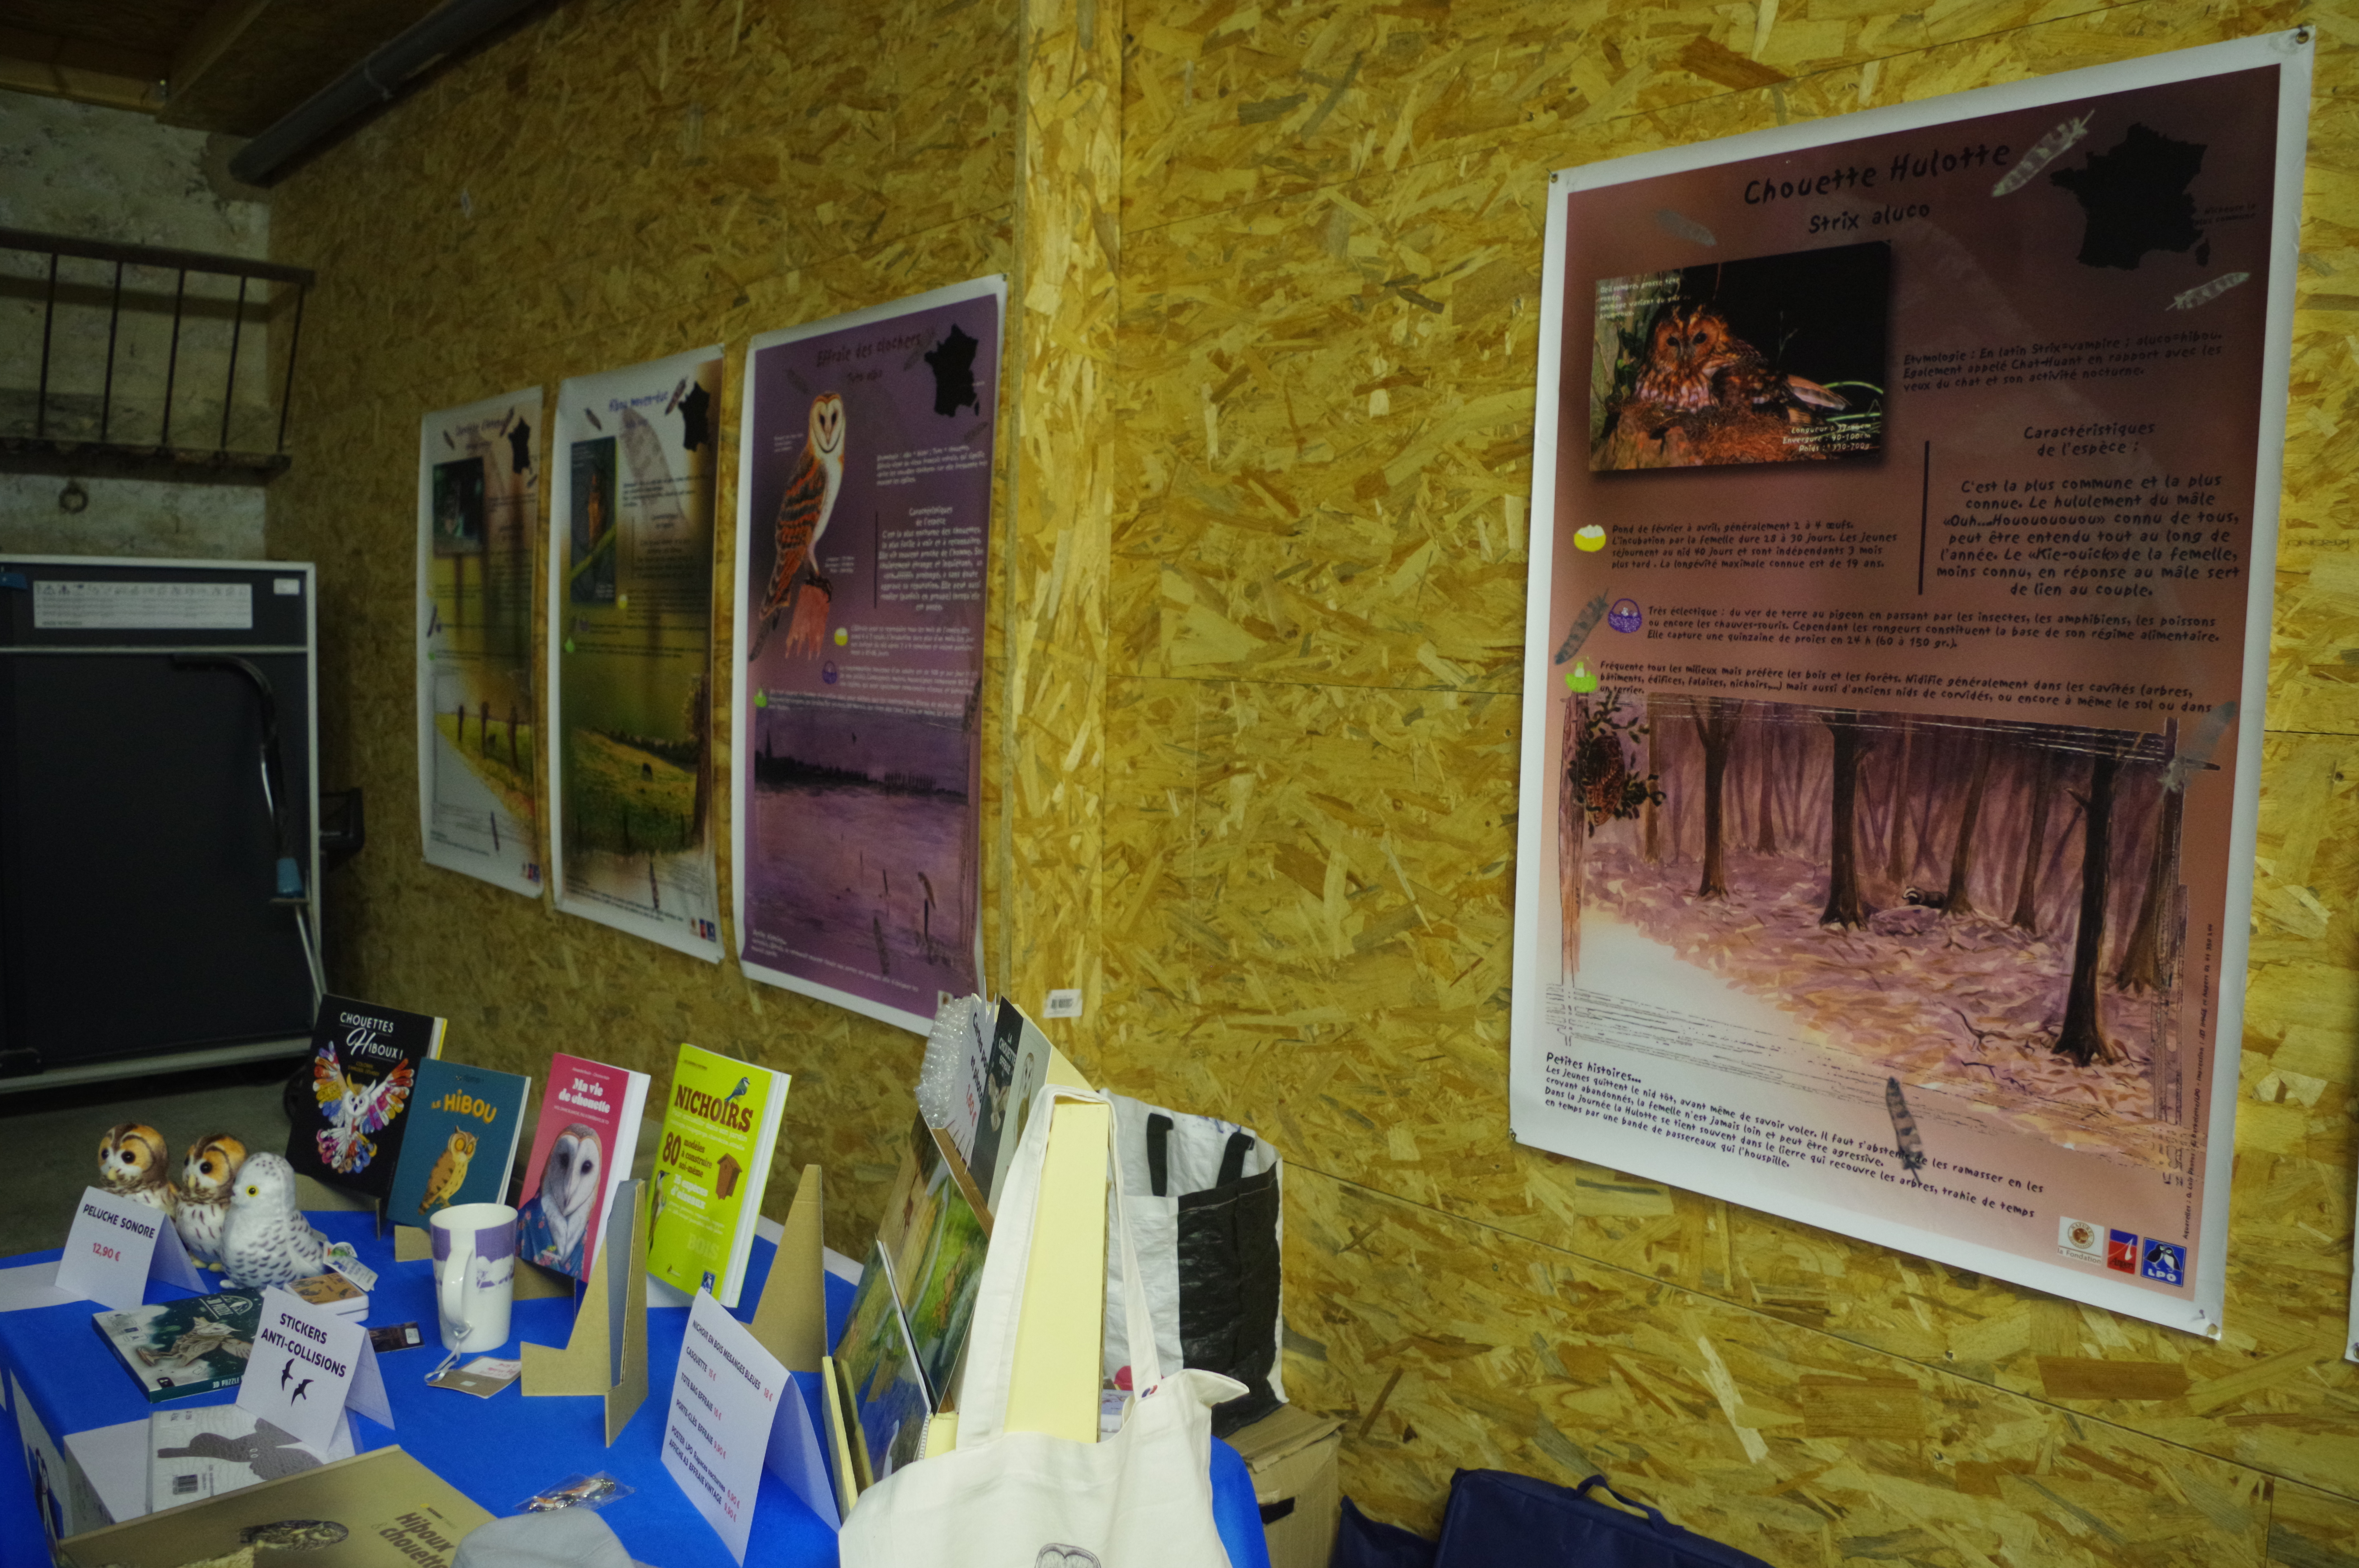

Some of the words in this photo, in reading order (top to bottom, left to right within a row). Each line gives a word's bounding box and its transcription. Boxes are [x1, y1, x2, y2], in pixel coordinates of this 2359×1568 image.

[1745, 168, 1876, 204] Chouette
[1890, 145, 2013, 180] Hulotte
[1808, 211, 1859, 234] Strix
[1872, 205, 1929, 224] aluco
[816, 347, 851, 367] Effraie
[856, 343, 872, 358] des
[1904, 350, 1966, 365] Etymologie
[1979, 348, 1994, 359] En
[1999, 345, 2026, 357] latin
[2032, 338, 2120, 354] Strix=vampire
[2137, 331, 2222, 345] aluco=hibou.
[1903, 365, 1962, 379] Egalement
[1968, 361, 2006, 373] appelé
[2012, 356, 2082, 369] Chat-Huant
[2088, 356, 2102, 364] en
[2109, 350, 2159, 362] rapport
[2165, 348, 2195, 358] avec
[2203, 345, 2222, 356] les
[2024, 423, 2155, 439] Caractéristiques
[2037, 444, 2055, 457] de
[2062, 443, 2126, 456] l'espèce
[1961, 480, 1997, 493] C'est
[2004, 479, 2017, 492] la
[2025, 479, 2054, 492] plus
[2062, 479, 2133, 489] commune
[2141, 476, 2157, 488] et
[2165, 474, 2179, 488] la
[2188, 474, 2222, 488] plus
[1966, 500, 2023, 509] connue.
[2029, 496, 2046, 509] Le
[2054, 495, 2141, 508] hululement
[2150, 494, 2168, 506] du
[2177, 492, 2215, 505] mâle
[1612, 524, 1634, 534] Pond
[1638, 525, 1648, 533] de
[1652, 524, 1683, 533] février
[1687, 523, 1692, 532] à
[1697, 523, 1720, 532] avril,
[1724, 522, 1790, 532] généralement
[1794, 521, 1799, 530] 2
[1805, 521, 1810, 529] à
[1815, 521, 1821, 529] 4
[2114, 514, 2161, 524] connu
[2171, 511, 2190, 524] de
[2197, 512, 2239, 524] tous,
[1949, 533, 1981, 545] peut
[1989, 531, 2020, 544] être
[2027, 530, 2090, 544] entendu
[2097, 531, 2132, 542] tout
[2140, 533, 2158, 542] au
[2166, 530, 2202, 543] long
[2211, 529, 2230, 542] de
[1941, 548, 1997, 561] l'année.
[2004, 548, 2022, 561] Le
[2122, 548, 2141, 559] de
[2148, 548, 2162, 561] la
[2170, 547, 2237, 561] femelle,
[1937, 565, 1976, 577] moins
[1983, 568, 2031, 579] connu,
[2038, 568, 2055, 578] en
[2064, 566, 2126, 579] réponse
[2134, 569, 2153, 578] au
[2161, 566, 2199, 579] mâle
[2208, 567, 2242, 582] sert
[2010, 583, 2027, 595] de
[2034, 583, 2061, 596] lien
[2070, 586, 2088, 595] au
[2096, 584, 2153, 597] couple.
[340, 1011, 394, 1033] CHOUETTES
[346, 1027, 398, 1058] HIBOUX
[1008, 1034, 1012, 1045] LA
[1547, 1052, 1582, 1069] Petites
[1587, 1062, 1641, 1083] histoires...
[572, 1077, 588, 1093] Ma
[589, 1082, 603, 1096] vie
[558, 1088, 571, 1102] de
[571, 1093, 611, 1114] chouette
[675, 1085, 754, 1133] NICHOIRS
[663, 1132, 681, 1165] 80
[684, 1139, 705, 1153] modèles
[678, 1161, 703, 1178] soi-même
[682, 1149, 685, 1157] à
[685, 1152, 712, 1169] construire
[84, 1204, 118, 1226] PELUCHE
[120, 1218, 156, 1239] SONORE
[92, 1242, 114, 1259] 12,90
[114, 1252, 121, 1262] €
[689, 1234, 719, 1260] BOIS
[2066, 1250, 2101, 1263] Fondation
[2148, 1269, 2176, 1281] LPO
[280, 1313, 327, 1345] STICKERS
[261, 1328, 347, 1378] ANTI-COLLISIONS
[686, 1346, 707, 1372] CASQUETTE
[712, 1373, 716, 1381] €
[692, 1320, 708, 1339] NICHOIR
[708, 1335, 714, 1345] EN
[714, 1340, 723, 1354] BOIS
[723, 1349, 745, 1374] MESANGES
[745, 1370, 760, 1390] BLEUES
[763, 1388, 769, 1398] 18
[769, 1393, 773, 1401] €
[222, 1377, 240, 1386] PUZZLE
[681, 1372, 690, 1387] TOTE
[698, 1390, 713, 1411] EFFRAIE
[676, 1398, 697, 1426] PORTE-CLÉS
[698, 1423, 713, 1445] EFFRAIE
[722, 1451, 726, 1459] €
[671, 1425, 685, 1445] POSTER
[693, 1450, 708, 1472] Rapaces
[708, 1467, 726, 1492] nocturnes
[736, 1501, 740, 1509] €
[669, 1438, 683, 1459] AFFICHE
[683, 1455, 689, 1465] A3
[689, 1461, 705, 1485] EFFRAIE
[704, 1480, 722, 1504] VINTAGE
[733, 1514, 737, 1522] €
[395, 1512, 455, 1553] Hiboux
